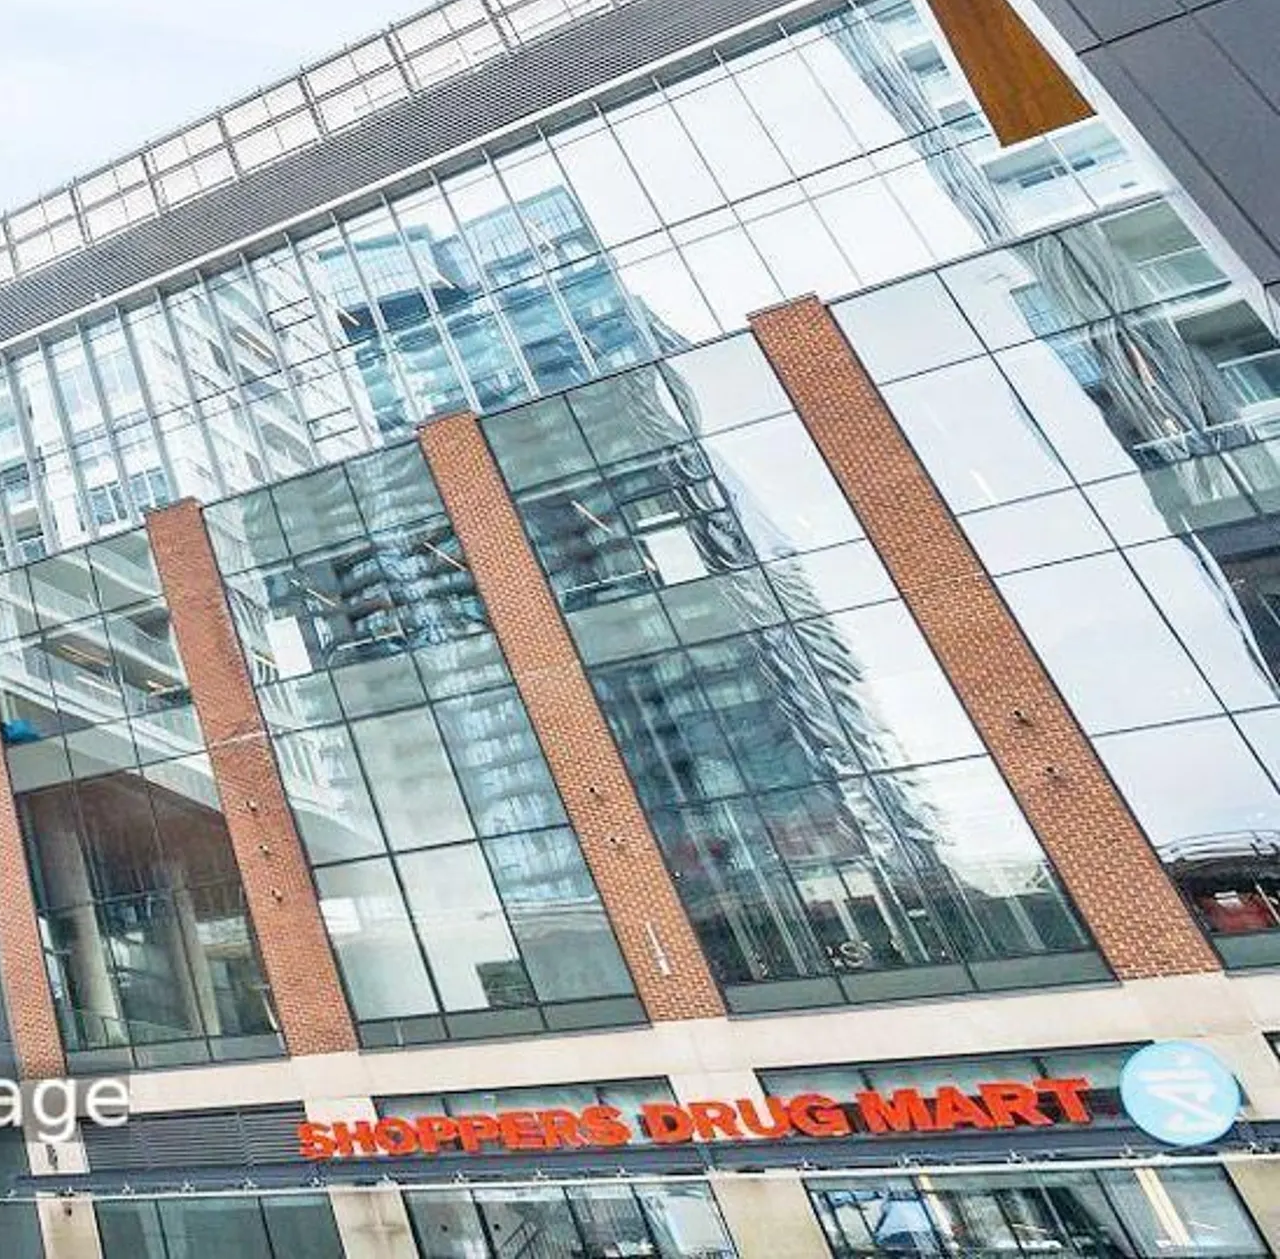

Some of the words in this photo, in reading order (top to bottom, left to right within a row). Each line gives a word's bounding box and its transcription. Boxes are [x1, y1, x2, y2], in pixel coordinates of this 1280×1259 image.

[299, 1103, 634, 1161] SHOPPERS
[642, 1093, 846, 1146] DRUG
[864, 1077, 1096, 1133] MART
